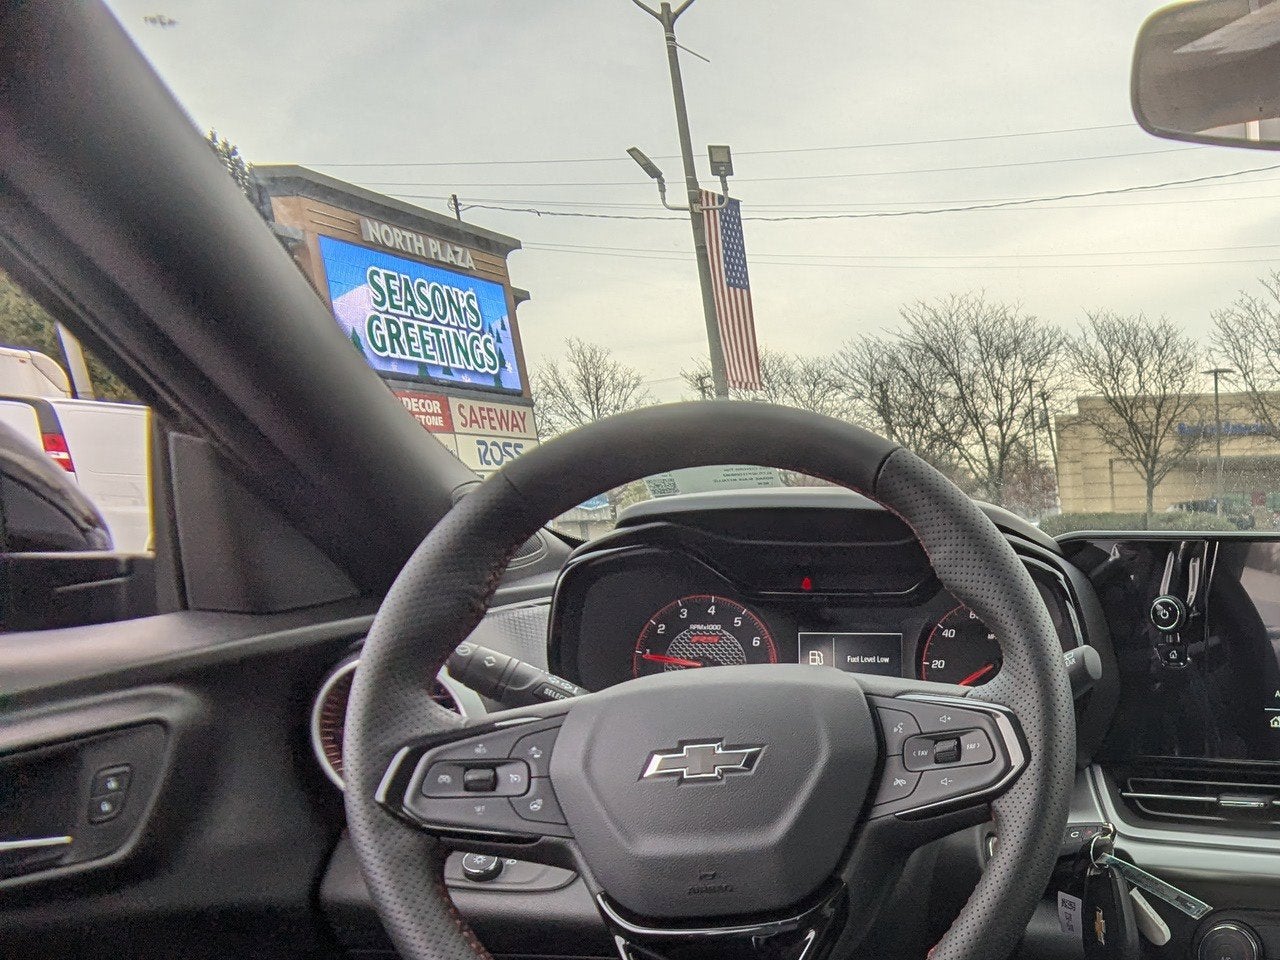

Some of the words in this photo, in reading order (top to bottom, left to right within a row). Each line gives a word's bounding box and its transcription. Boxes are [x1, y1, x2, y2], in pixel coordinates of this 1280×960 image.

[365, 218, 426, 258] NORTH
[428, 237, 476, 271] PLAZA
[367, 266, 482, 331] SEASON'S
[366, 312, 500, 374] GREETINGS
[401, 397, 442, 414] DECOR
[458, 404, 526, 433] SAFEWAY
[680, 608, 688, 619] 3
[708, 605, 716, 615] 4
[733, 617, 742, 627] 5
[657, 624, 666, 634] 2
[942, 628, 956, 638] 40
[753, 636, 760, 647] 6
[931, 660, 945, 669] 20
[544, 688, 568, 700] SELEC
